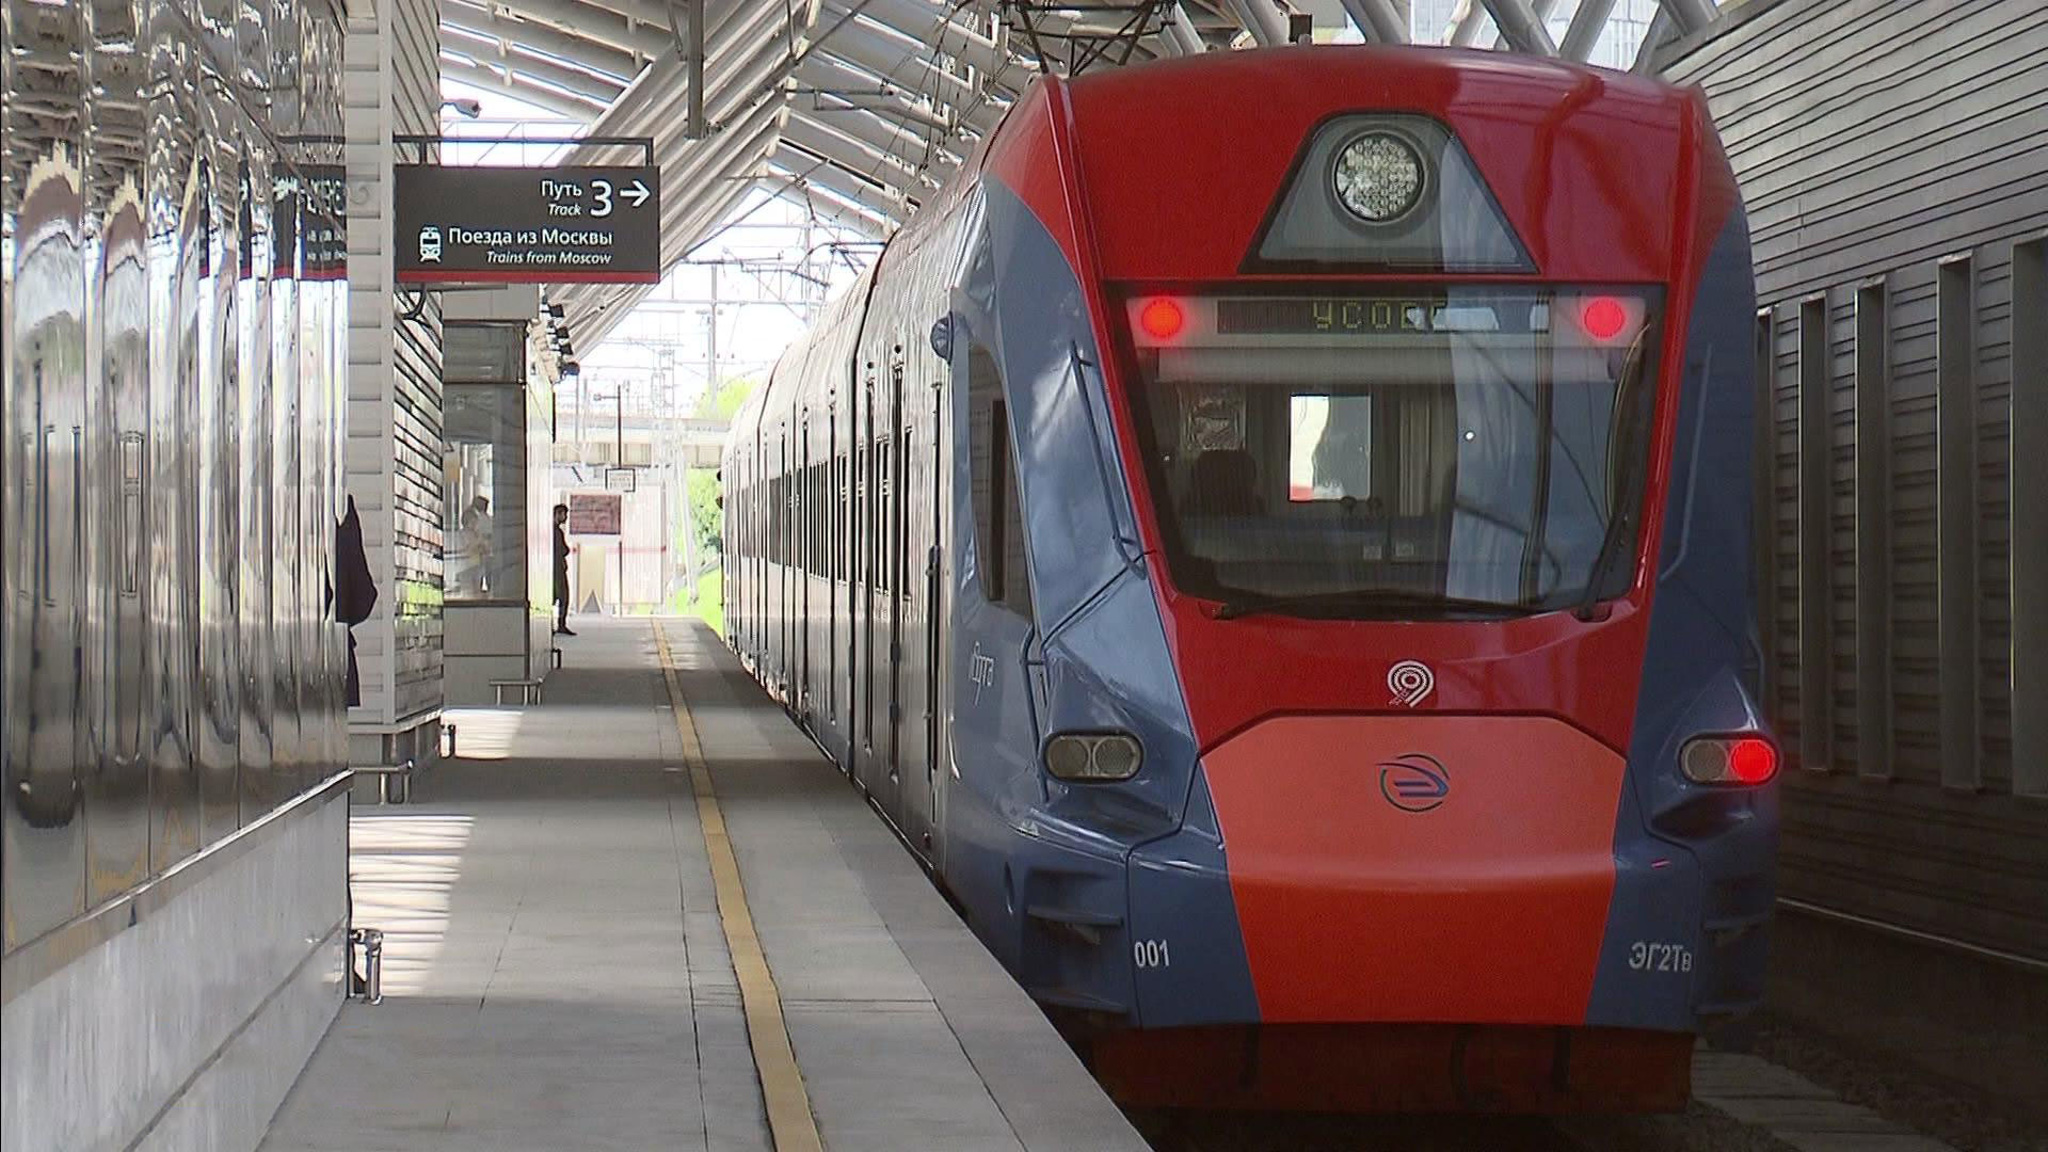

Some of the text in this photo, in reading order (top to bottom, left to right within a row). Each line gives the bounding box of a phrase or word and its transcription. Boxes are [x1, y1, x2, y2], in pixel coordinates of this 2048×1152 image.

[541, 180, 613, 217] Путь 3
[548, 203, 581, 216] Track
[448, 228, 613, 246] Поезда из Москвы
[486, 251, 612, 264] Trains from Moscow
[1134, 939, 1170, 968] 001
